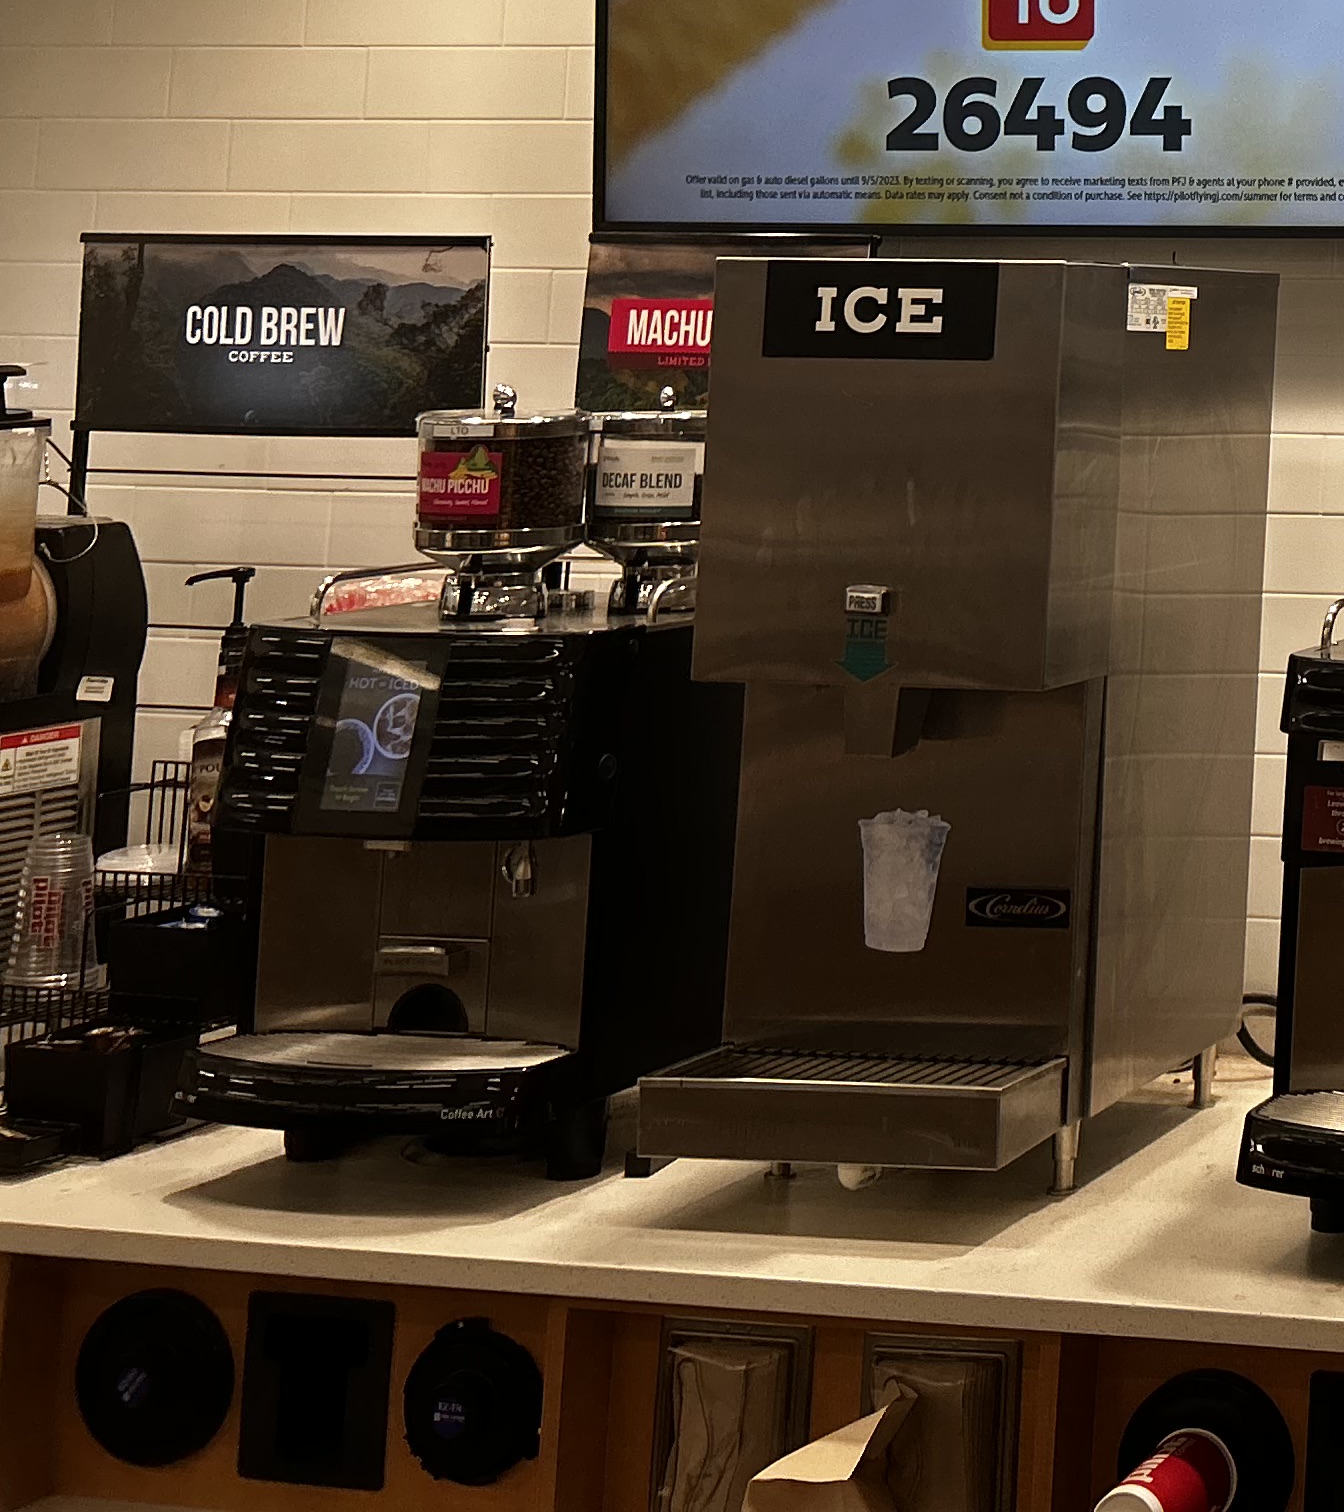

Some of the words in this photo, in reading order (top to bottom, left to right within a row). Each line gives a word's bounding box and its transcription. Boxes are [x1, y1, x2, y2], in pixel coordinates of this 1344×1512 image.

[886, 76, 1192, 152] 26494
[708, 175, 727, 185] valid
[764, 175, 782, 185] auto
[784, 175, 808, 185] diesel
[810, 175, 839, 187] gallons
[841, 175, 859, 185] until
[862, 175, 901, 185] 9/5/2023.
[916, 175, 943, 187] texting
[957, 175, 995, 187] scanning,
[997, 177, 1013, 187] you
[1016, 177, 1038, 187] agree
[1052, 176, 1081, 186] receive
[1083, 176, 1125, 188] marketing
[1128, 176, 1148, 186] texts
[1150, 176, 1170, 186] from
[1197, 176, 1224, 188] agents
[1236, 178, 1256, 188] your
[1258, 176, 1285, 188] phone
[1296, 176, 1335, 188] provided,
[716, 189, 753, 201] including
[756, 189, 778, 199] those
[780, 189, 797, 199] sent
[812, 190, 852, 200] automatic
[854, 192, 881, 200] means.
[885, 190, 904, 200] Data
[906, 190, 926, 200] rates
[928, 192, 944, 202] may
[947, 190, 970, 202] apply.
[973, 190, 1007, 200] Consent
[1032, 190, 1072, 200] condition
[1085, 190, 1124, 202] purchase.
[1127, 191, 1142, 201] See
[1294, 191, 1318, 201] terms
[1320, 191, 1336, 201] and
[815, 286, 943, 334] ICE
[185, 305, 253, 345] COLD
[260, 307, 346, 346] BREW
[626, 309, 714, 347] MACHU
[228, 350, 294, 363] COFFEE
[657, 356, 705, 366] LIMITED
[447, 478, 489, 494] PICCHU
[602, 472, 637, 488] DECAF
[640, 473, 682, 489] BLEND
[849, 595, 877, 610] PRESS
[847, 618, 887, 639] ICE
[351, 677, 378, 688] HOT
[986, 893, 1050, 917] Cornelius
[440, 1108, 474, 1120] Coffee
[475, 1107, 493, 1119] Art
